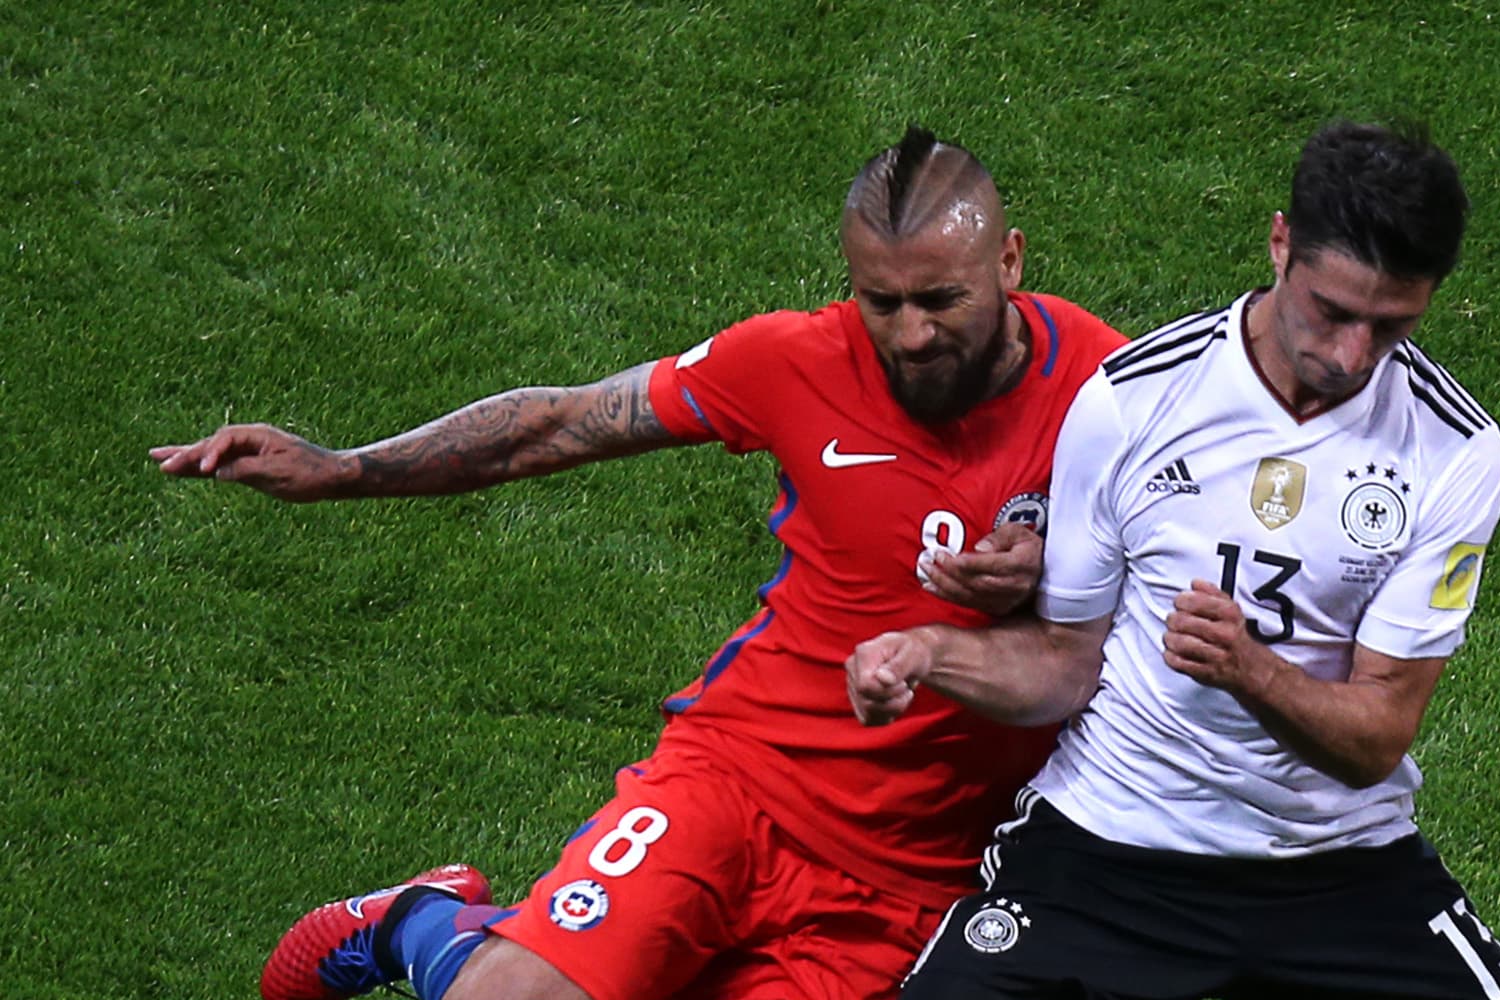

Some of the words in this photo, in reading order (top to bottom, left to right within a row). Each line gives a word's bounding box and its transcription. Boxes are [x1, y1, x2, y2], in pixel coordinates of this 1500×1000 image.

[916, 509, 965, 588] 8
[1216, 542, 1301, 645] 13
[588, 806, 669, 877] 8
